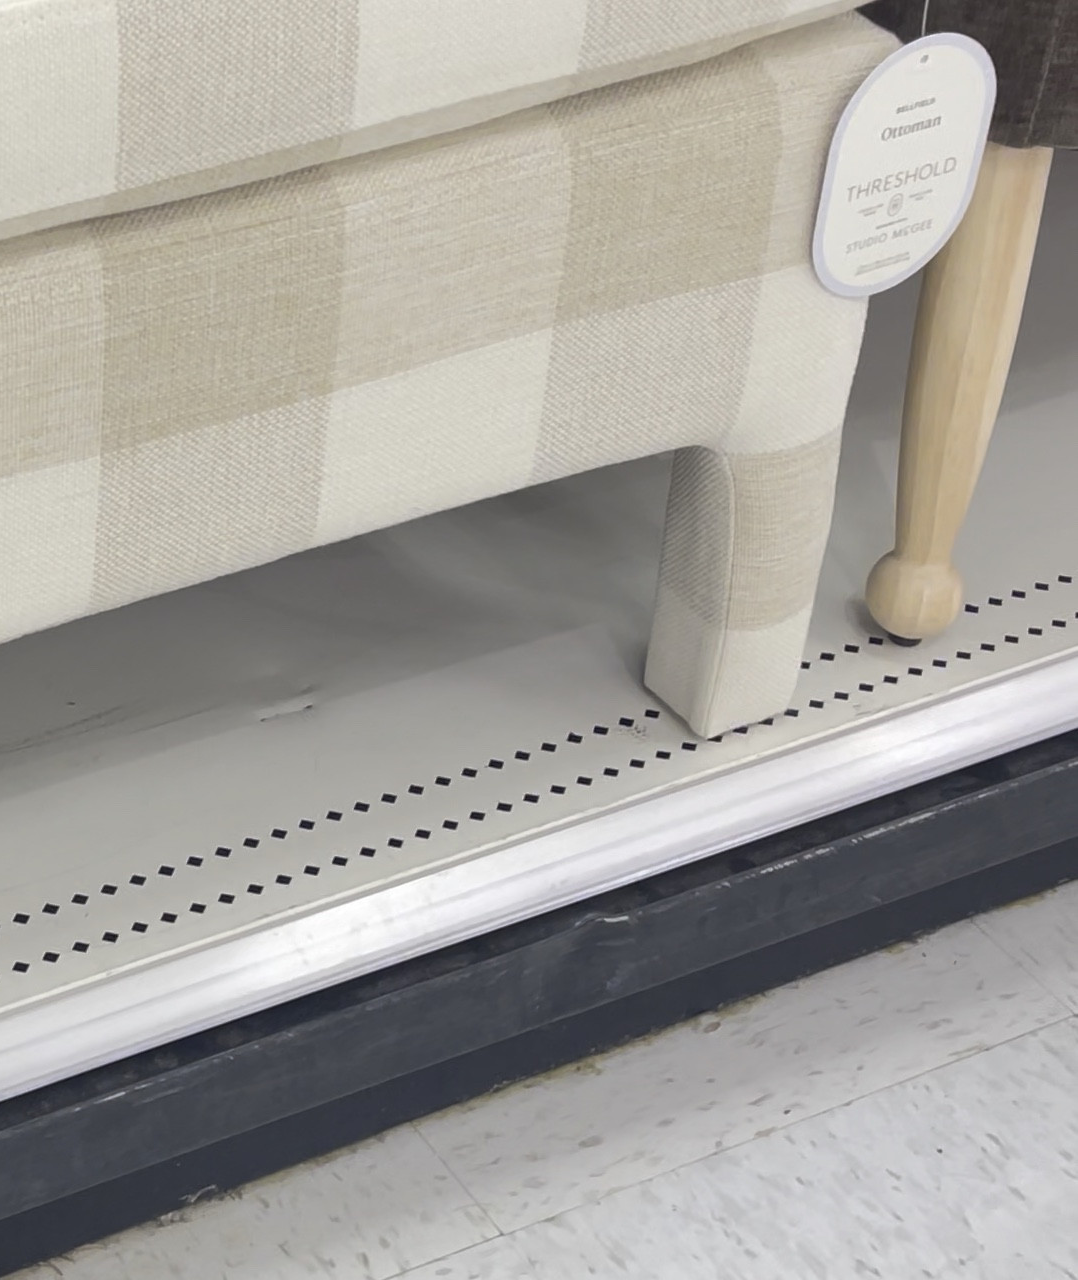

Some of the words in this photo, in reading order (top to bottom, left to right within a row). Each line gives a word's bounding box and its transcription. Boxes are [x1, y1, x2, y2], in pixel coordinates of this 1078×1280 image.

[881, 115, 942, 141] Ottoman
[846, 157, 957, 202] THRESHOLD
[846, 232, 888, 254] STUDIO
